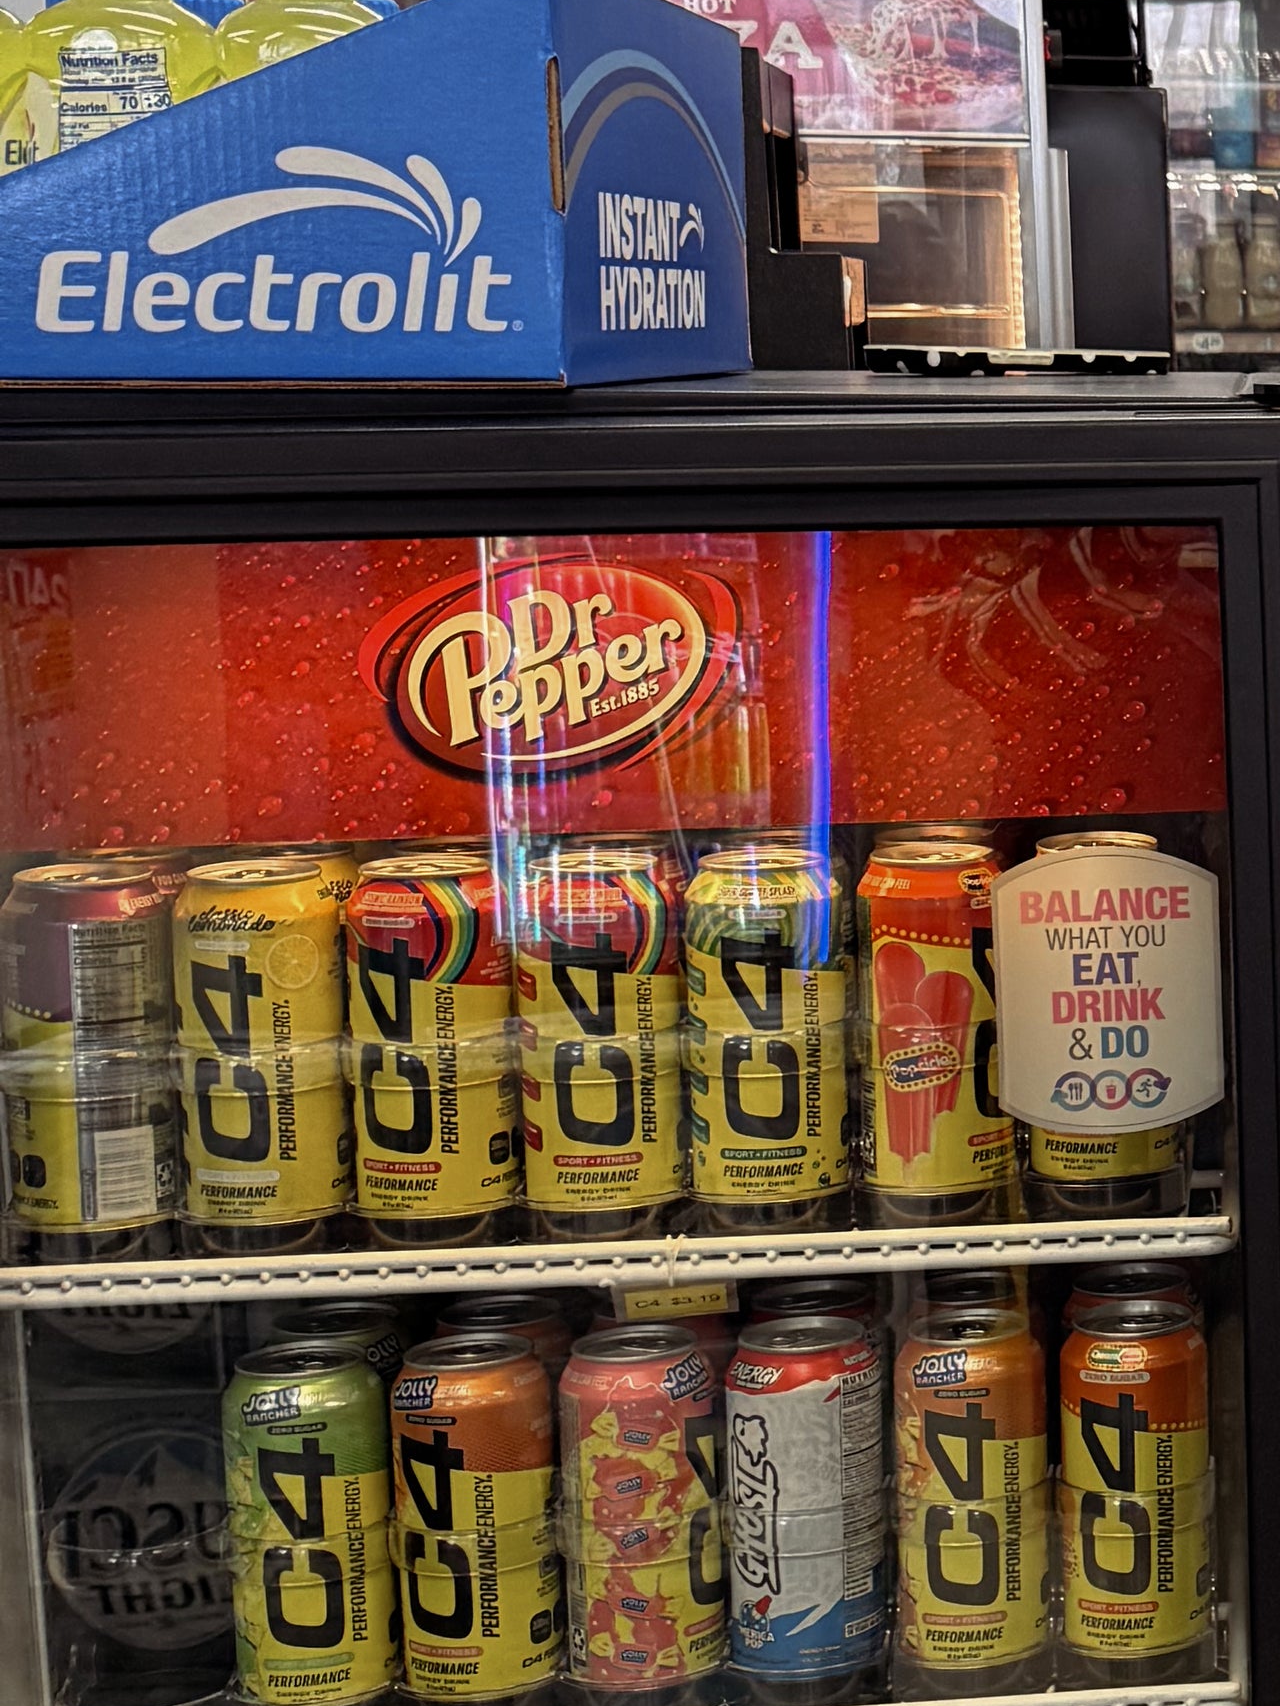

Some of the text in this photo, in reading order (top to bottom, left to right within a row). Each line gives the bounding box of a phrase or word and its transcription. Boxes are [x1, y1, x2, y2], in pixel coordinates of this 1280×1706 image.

[121, 51, 158, 66] Facts
[598, 192, 681, 263] INSTANT
[35, 250, 513, 333] Electrolit
[600, 265, 706, 332] HYDRATION
[506, 589, 613, 670] Dr
[407, 610, 684, 747] Pepper
[1019, 885, 1191, 924] BALANCE
[1045, 924, 1167, 951] WHAT YOU
[1072, 951, 1142, 988] EAT,
[1051, 986, 1166, 1025] DRINK
[358, 937, 433, 1155] C4
[550, 932, 636, 1147] C4
[720, 927, 800, 1141] C4
[1068, 1024, 1149, 1061] & DO
[190, 955, 272, 1163] C4
[1044, 1138, 1119, 1155] PERFORMANCE
[556, 1168, 640, 1186] PERFORMANCE
[723, 1161, 805, 1179] PERFORMANCE
[916, 1350, 967, 1377] JOLLY
[916, 1372, 965, 1387] RANCHER
[245, 1388, 301, 1414] JOLLY
[394, 1376, 438, 1398] JOLLY
[1156, 1434, 1175, 1593] PERFORMANCE ENERGY.
[257, 1437, 346, 1649] C4
[400, 1429, 475, 1640] C4
[343, 1476, 369, 1642] PERFORMANCE ENERGY.
[474, 1473, 501, 1638] PERFORMANCE ENERGY.
[925, 1626, 1004, 1643] PERFORMANCE
[1080, 1614, 1155, 1631] PERFORMANCE
